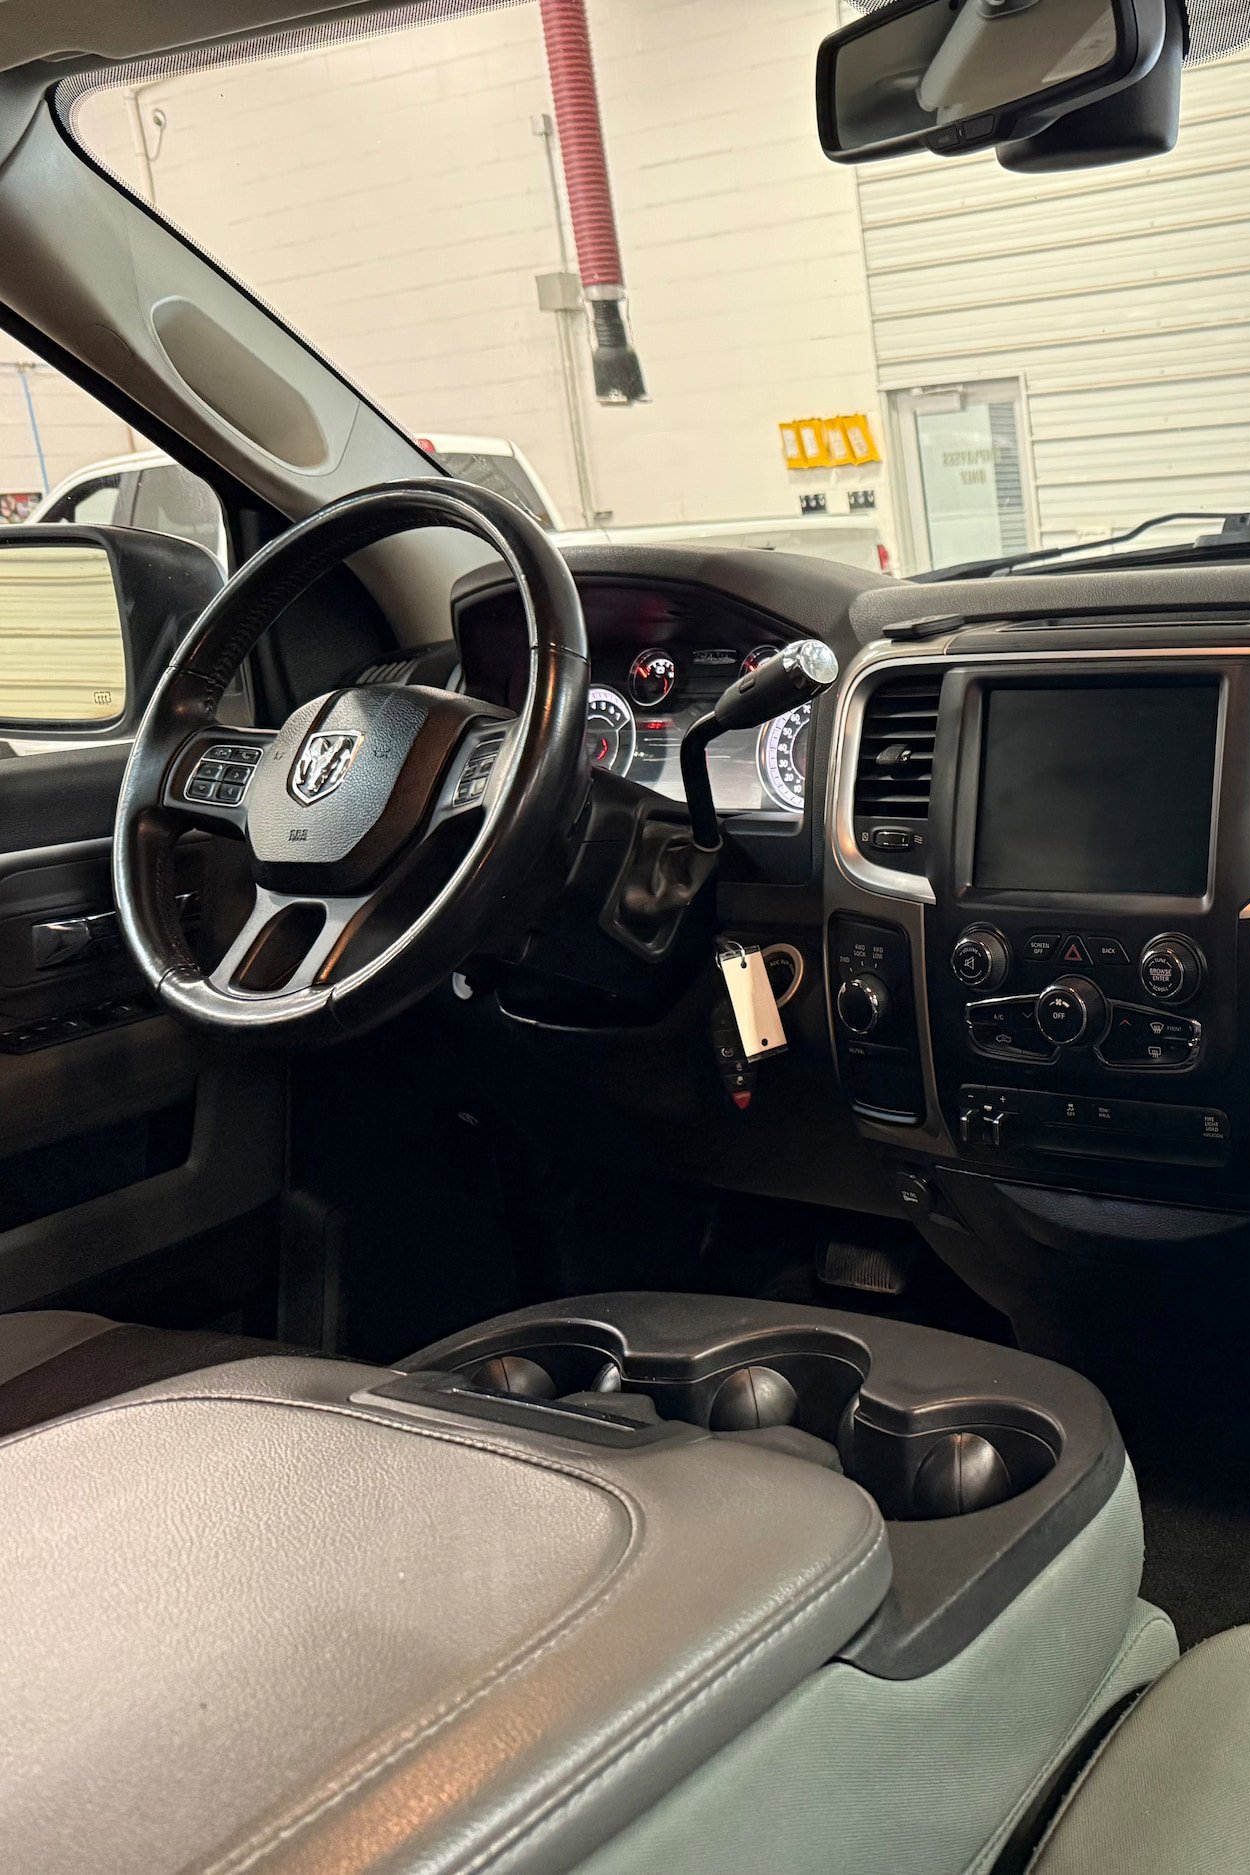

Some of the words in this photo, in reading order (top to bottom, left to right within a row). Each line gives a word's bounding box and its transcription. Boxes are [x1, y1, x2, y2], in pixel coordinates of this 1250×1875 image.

[783, 727, 792, 736] 50
[779, 759, 788, 768] 30
[1101, 947, 1115, 955] BACK
[1149, 967, 1172, 976] BROWSE
[1052, 1012, 1066, 1020] OFF
